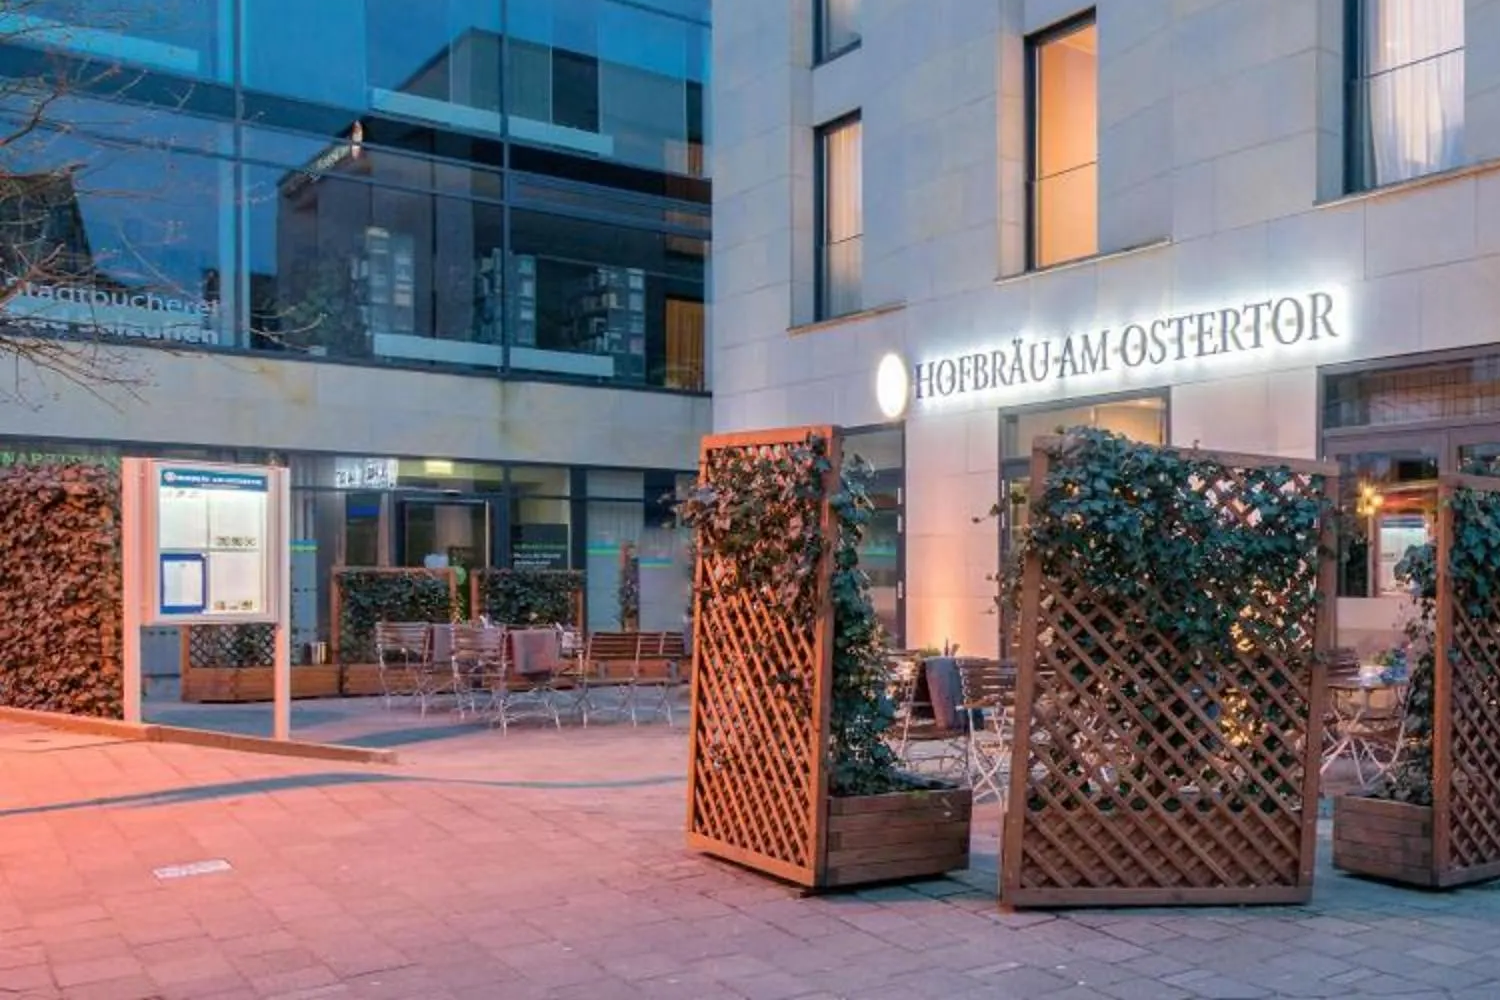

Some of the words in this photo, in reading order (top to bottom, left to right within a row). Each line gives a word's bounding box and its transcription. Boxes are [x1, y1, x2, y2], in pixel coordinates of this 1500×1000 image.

[914, 336, 1051, 400] HOFBRÄU
[1056, 329, 1111, 380] AM
[1120, 291, 1340, 368] OSTERTOR
